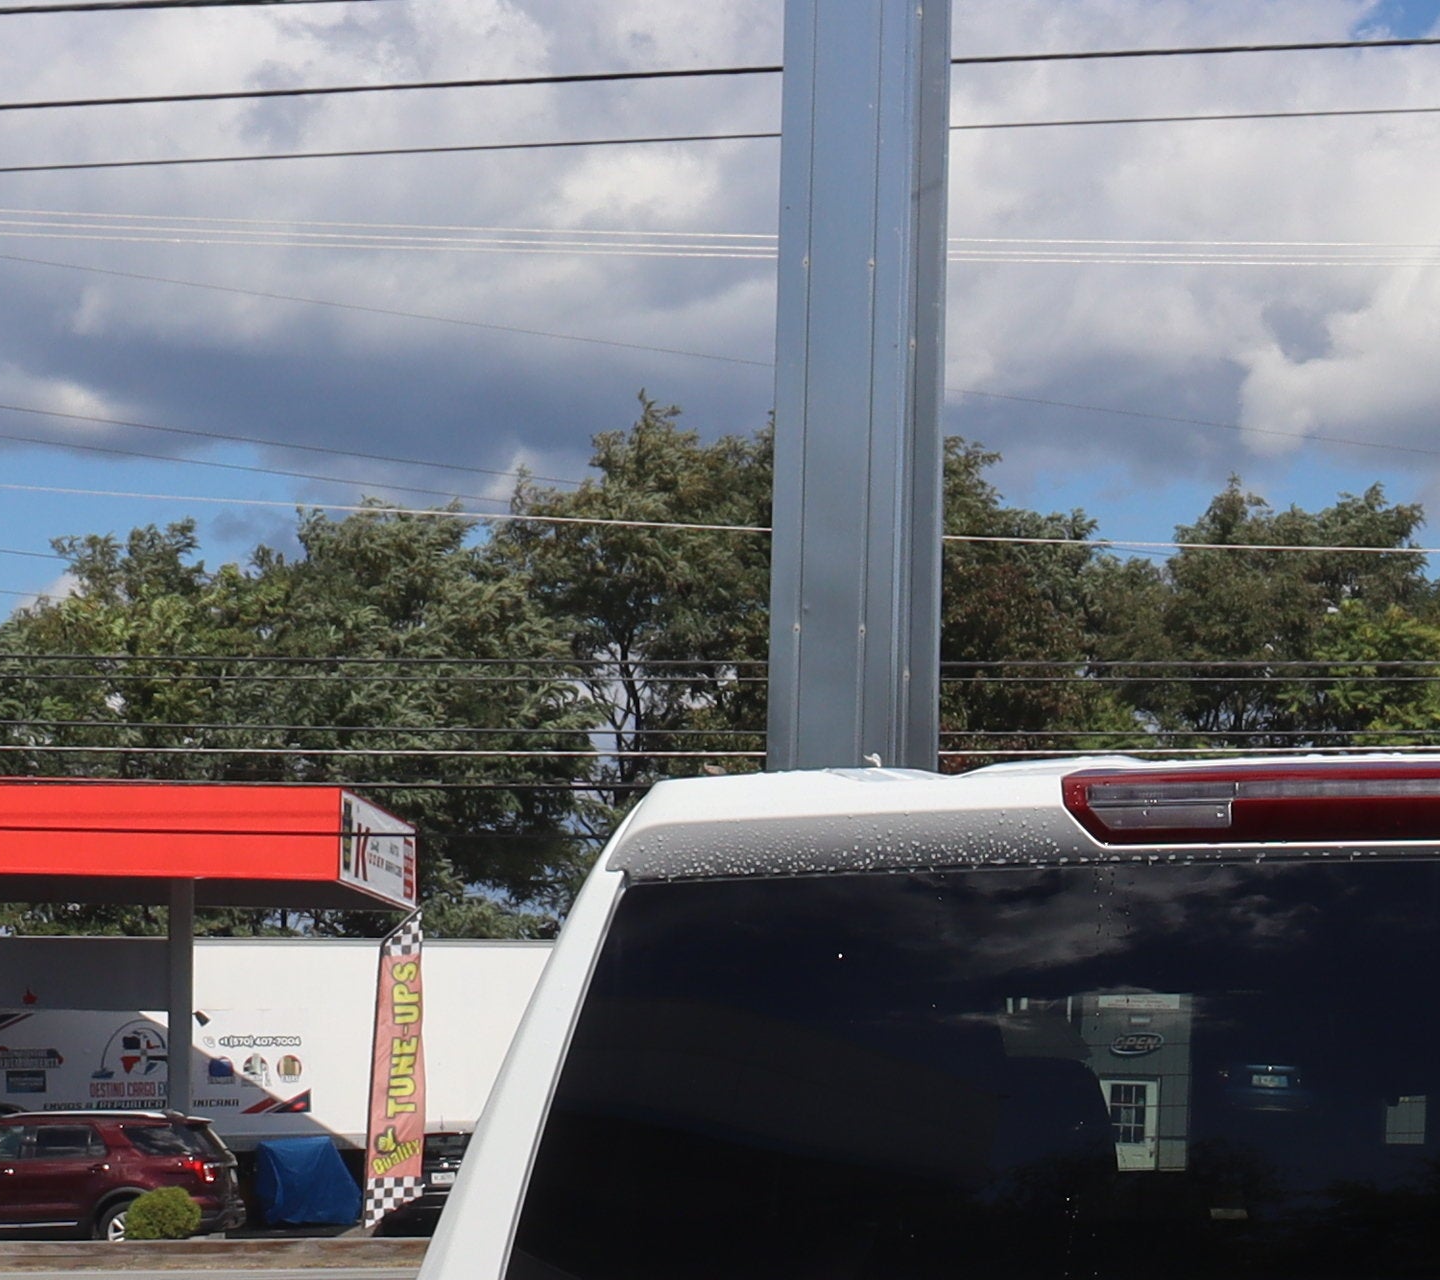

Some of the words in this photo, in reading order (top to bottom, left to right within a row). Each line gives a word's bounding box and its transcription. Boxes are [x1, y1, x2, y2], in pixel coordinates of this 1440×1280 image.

[387, 961, 420, 1119] TUNE-UPS
[90, 1082, 125, 1098] DESTINO
[127, 1082, 157, 1098] CARGO
[371, 1138, 421, 1176] Quality
